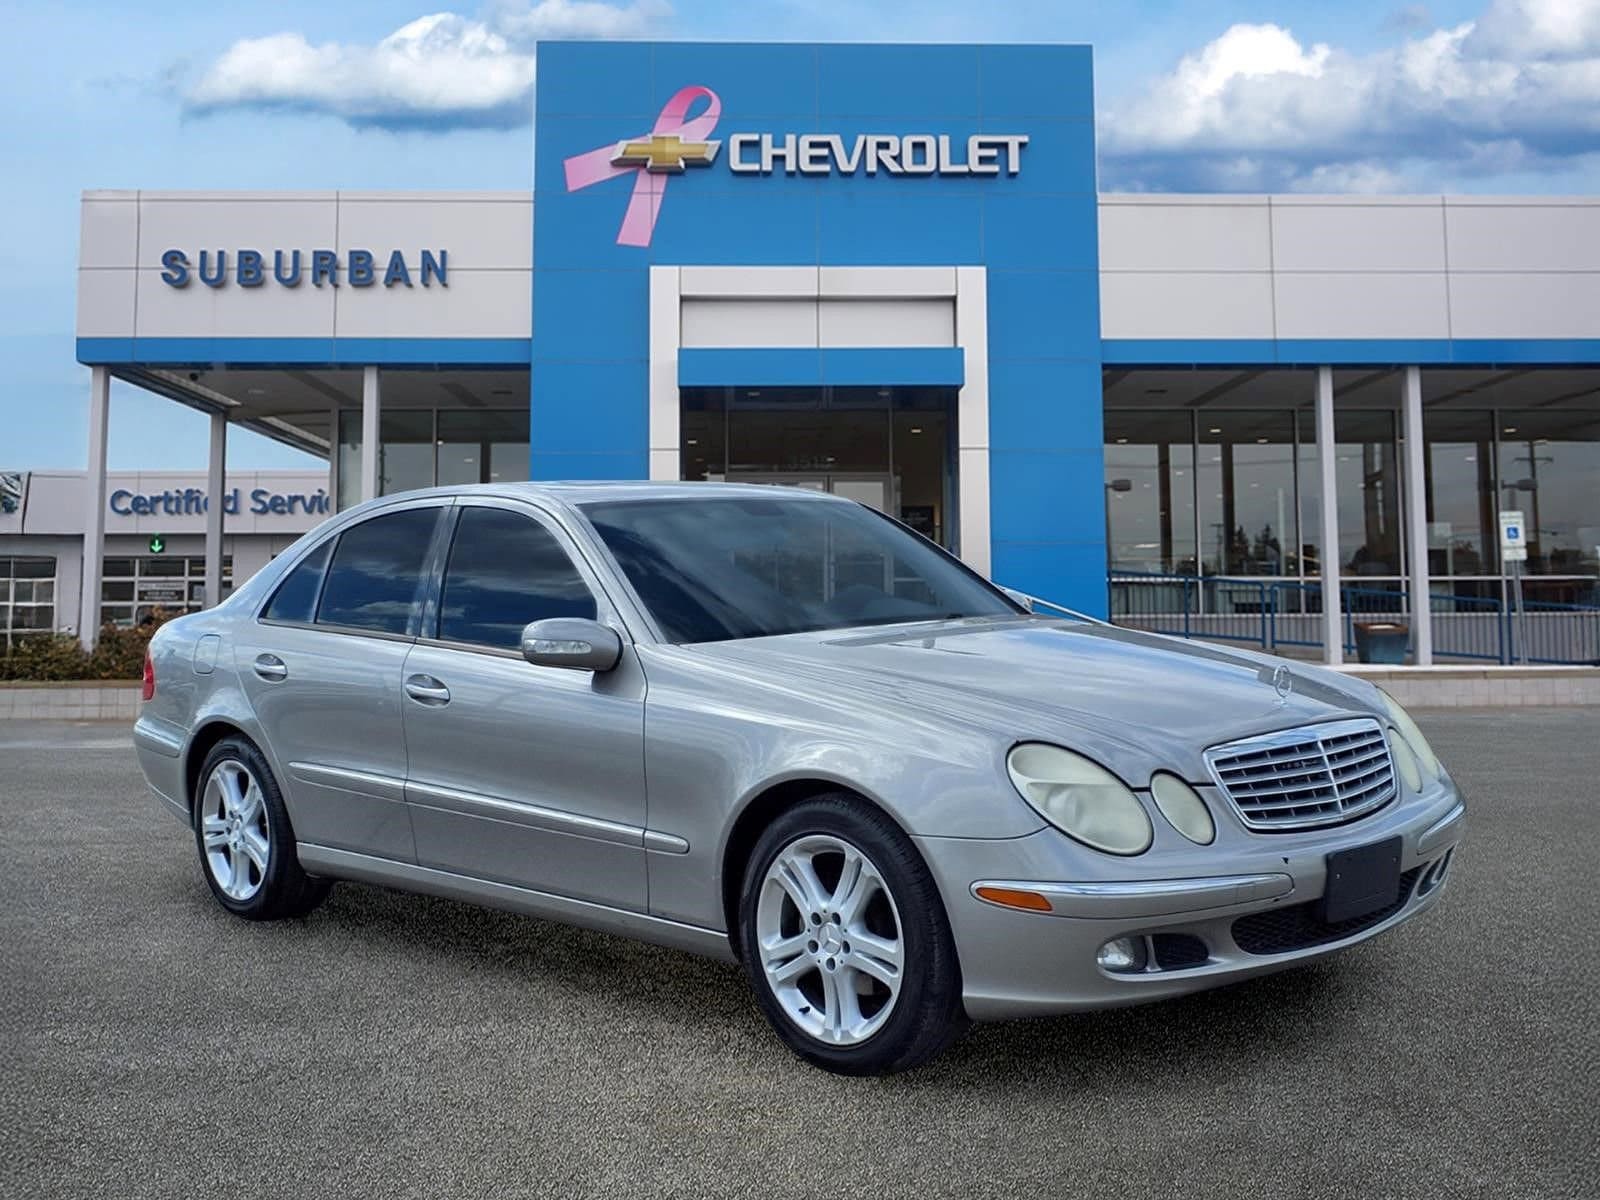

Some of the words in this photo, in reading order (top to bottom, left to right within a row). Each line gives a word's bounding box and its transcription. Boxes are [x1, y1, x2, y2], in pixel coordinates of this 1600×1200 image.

[729, 134, 1029, 175] CHEVROLET
[161, 249, 449, 287] SUBURBAN
[110, 488, 240, 515] Certifid
